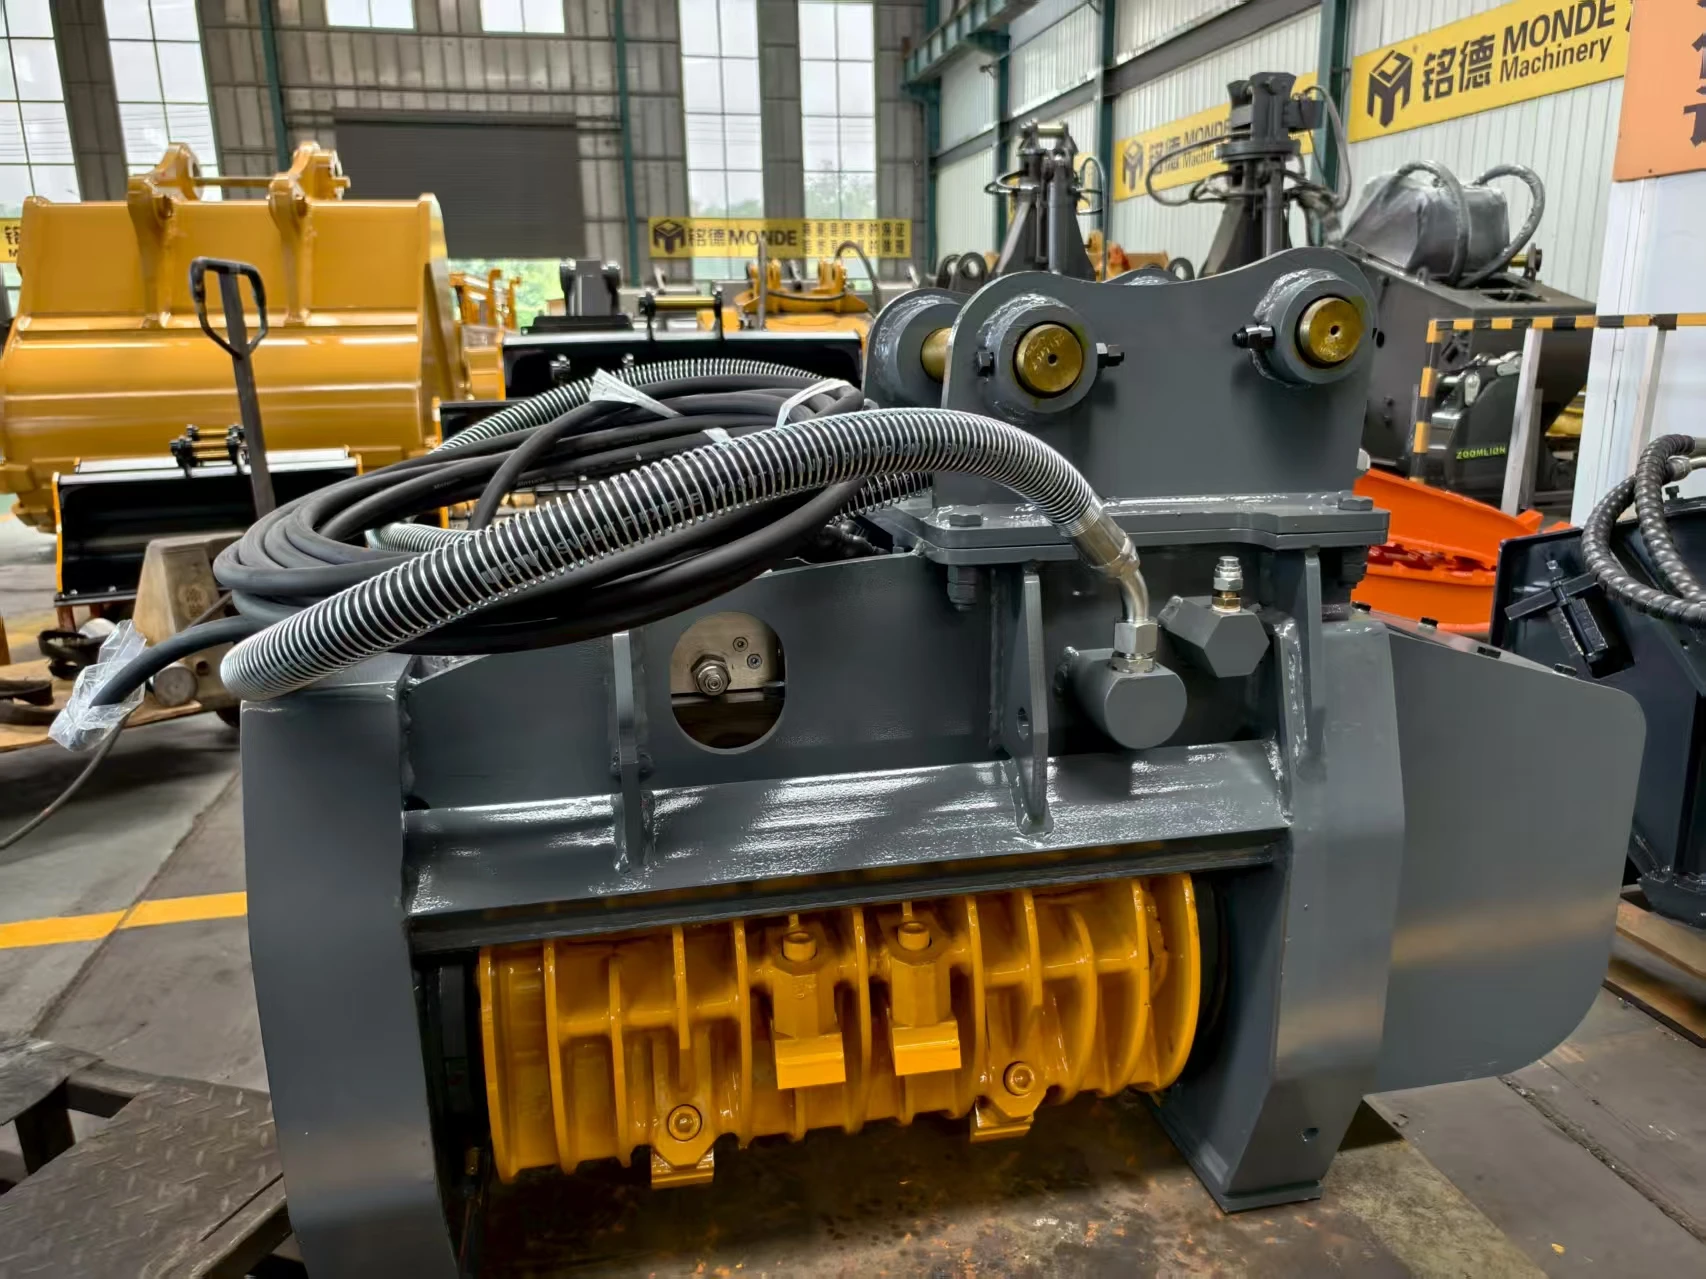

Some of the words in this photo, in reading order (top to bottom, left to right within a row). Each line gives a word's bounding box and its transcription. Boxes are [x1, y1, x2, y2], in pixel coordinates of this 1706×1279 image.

[1502, 0, 1616, 57] MONDE
[1422, 34, 1496, 102] 铭德
[1499, 36, 1612, 83] Machinery
[728, 229, 797, 247] MONDE
[1456, 444, 1506, 460] ZOOMLION
